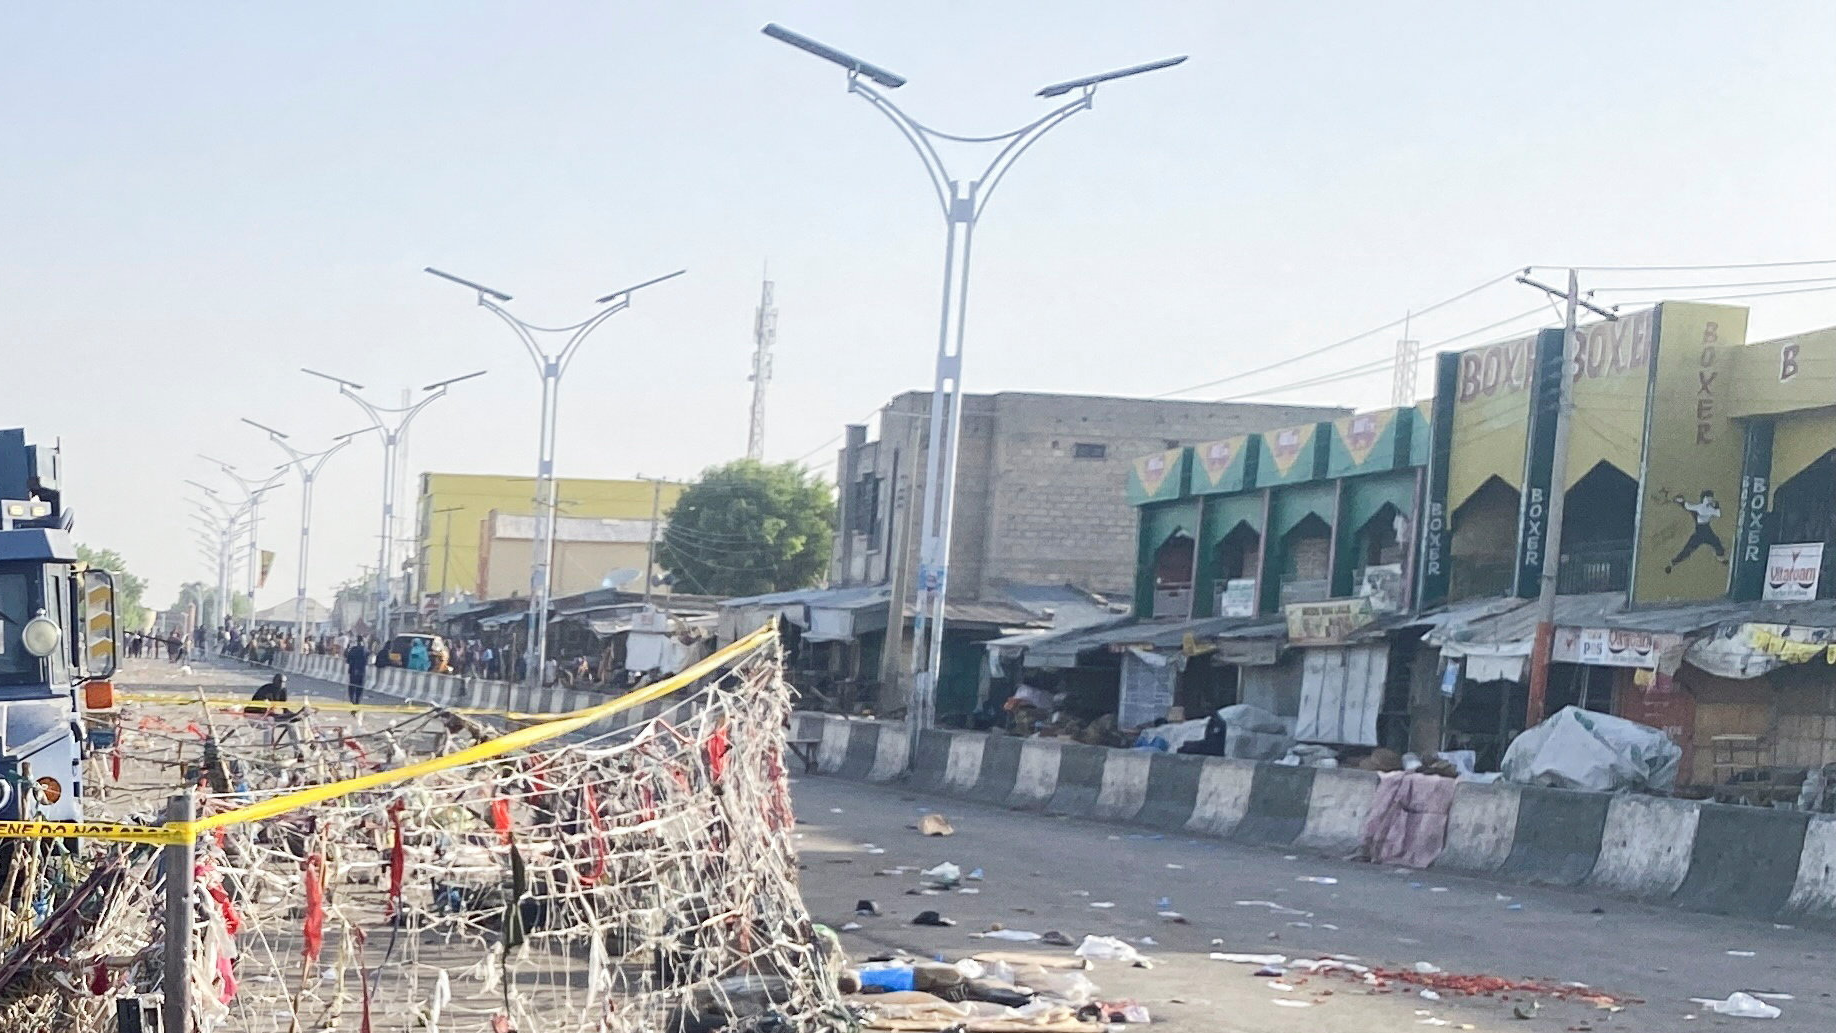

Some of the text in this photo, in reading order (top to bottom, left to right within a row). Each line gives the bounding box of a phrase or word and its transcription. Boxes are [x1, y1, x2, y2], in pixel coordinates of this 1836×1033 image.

[1696, 321, 1718, 445] BOXER
[1428, 502, 1442, 575] BOXER
[1526, 488, 1543, 565] BOXER
[1745, 477, 1766, 561] BOXER
